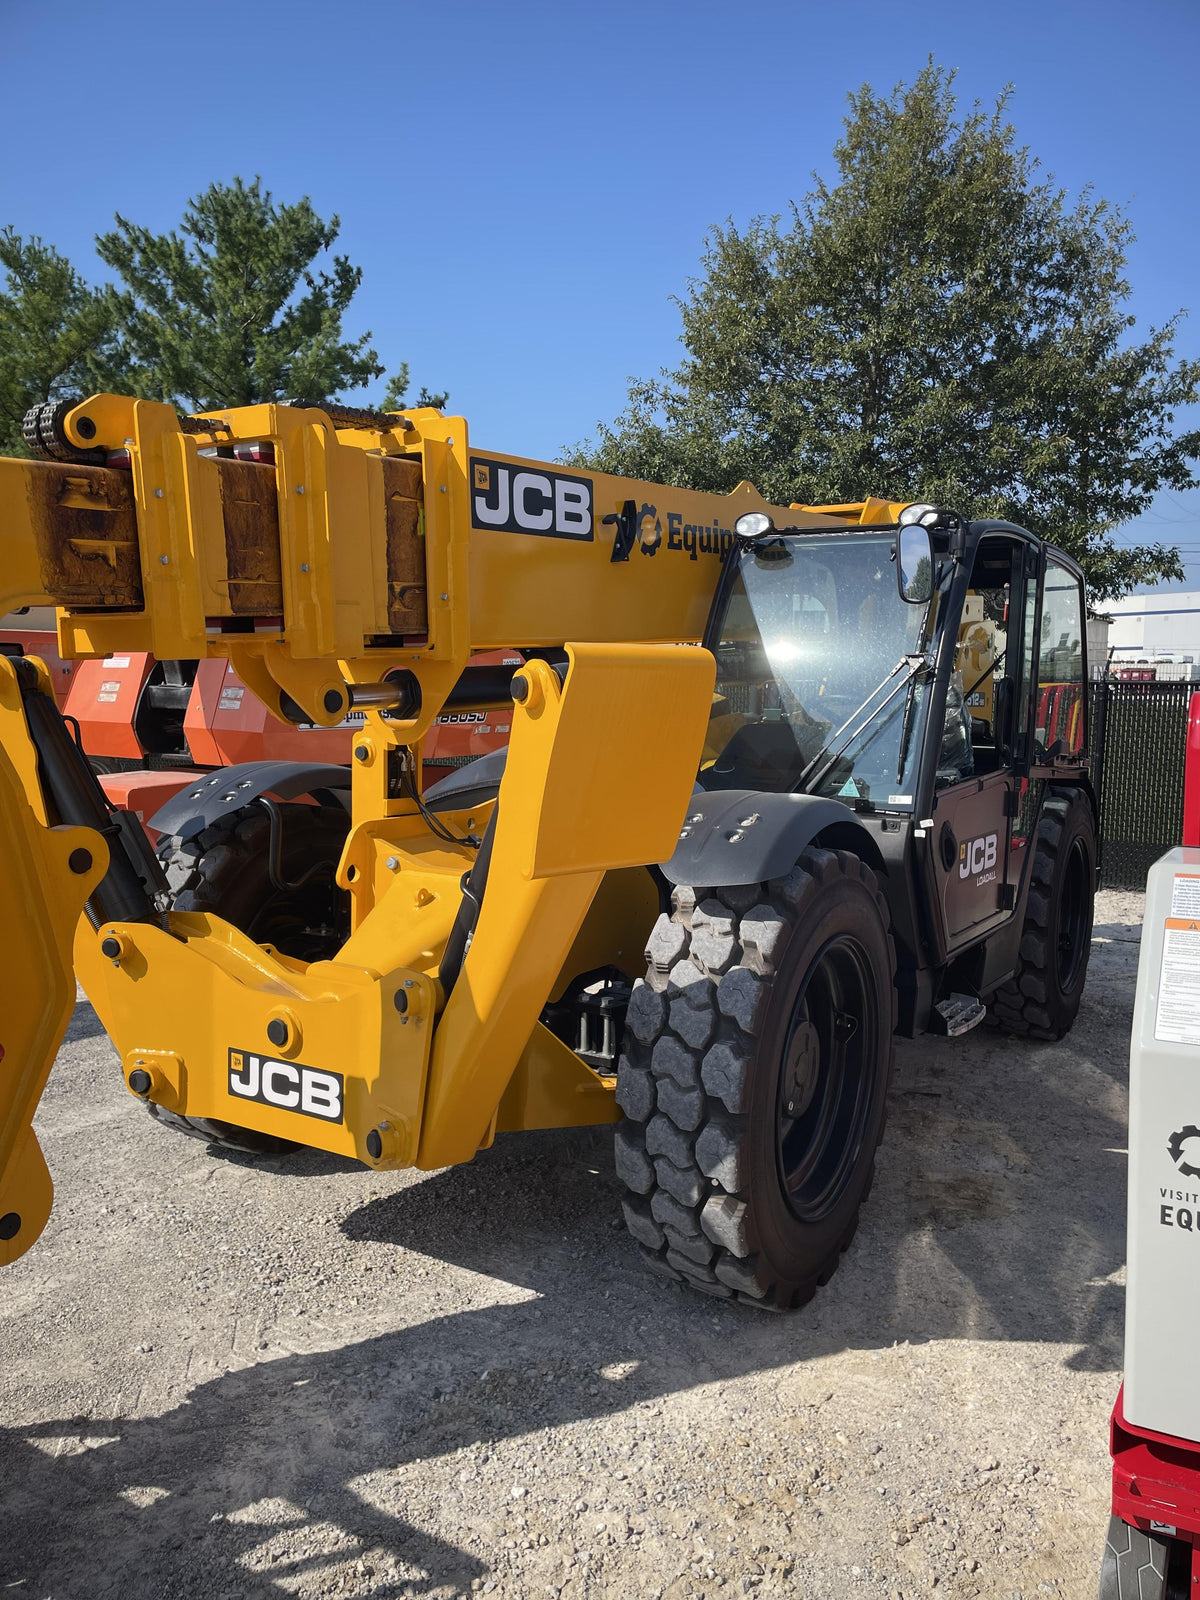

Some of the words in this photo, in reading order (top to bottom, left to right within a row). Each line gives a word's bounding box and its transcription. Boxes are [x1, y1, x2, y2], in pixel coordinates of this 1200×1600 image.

[475, 468, 592, 535] JCB
[667, 512, 737, 563] Equip
[959, 833, 998, 879] JCB
[976, 871, 997, 887] LOADALL
[230, 1056, 341, 1118] JCB
[1160, 1187, 1199, 1204] VISIT
[1160, 1204, 1200, 1232] EQ
